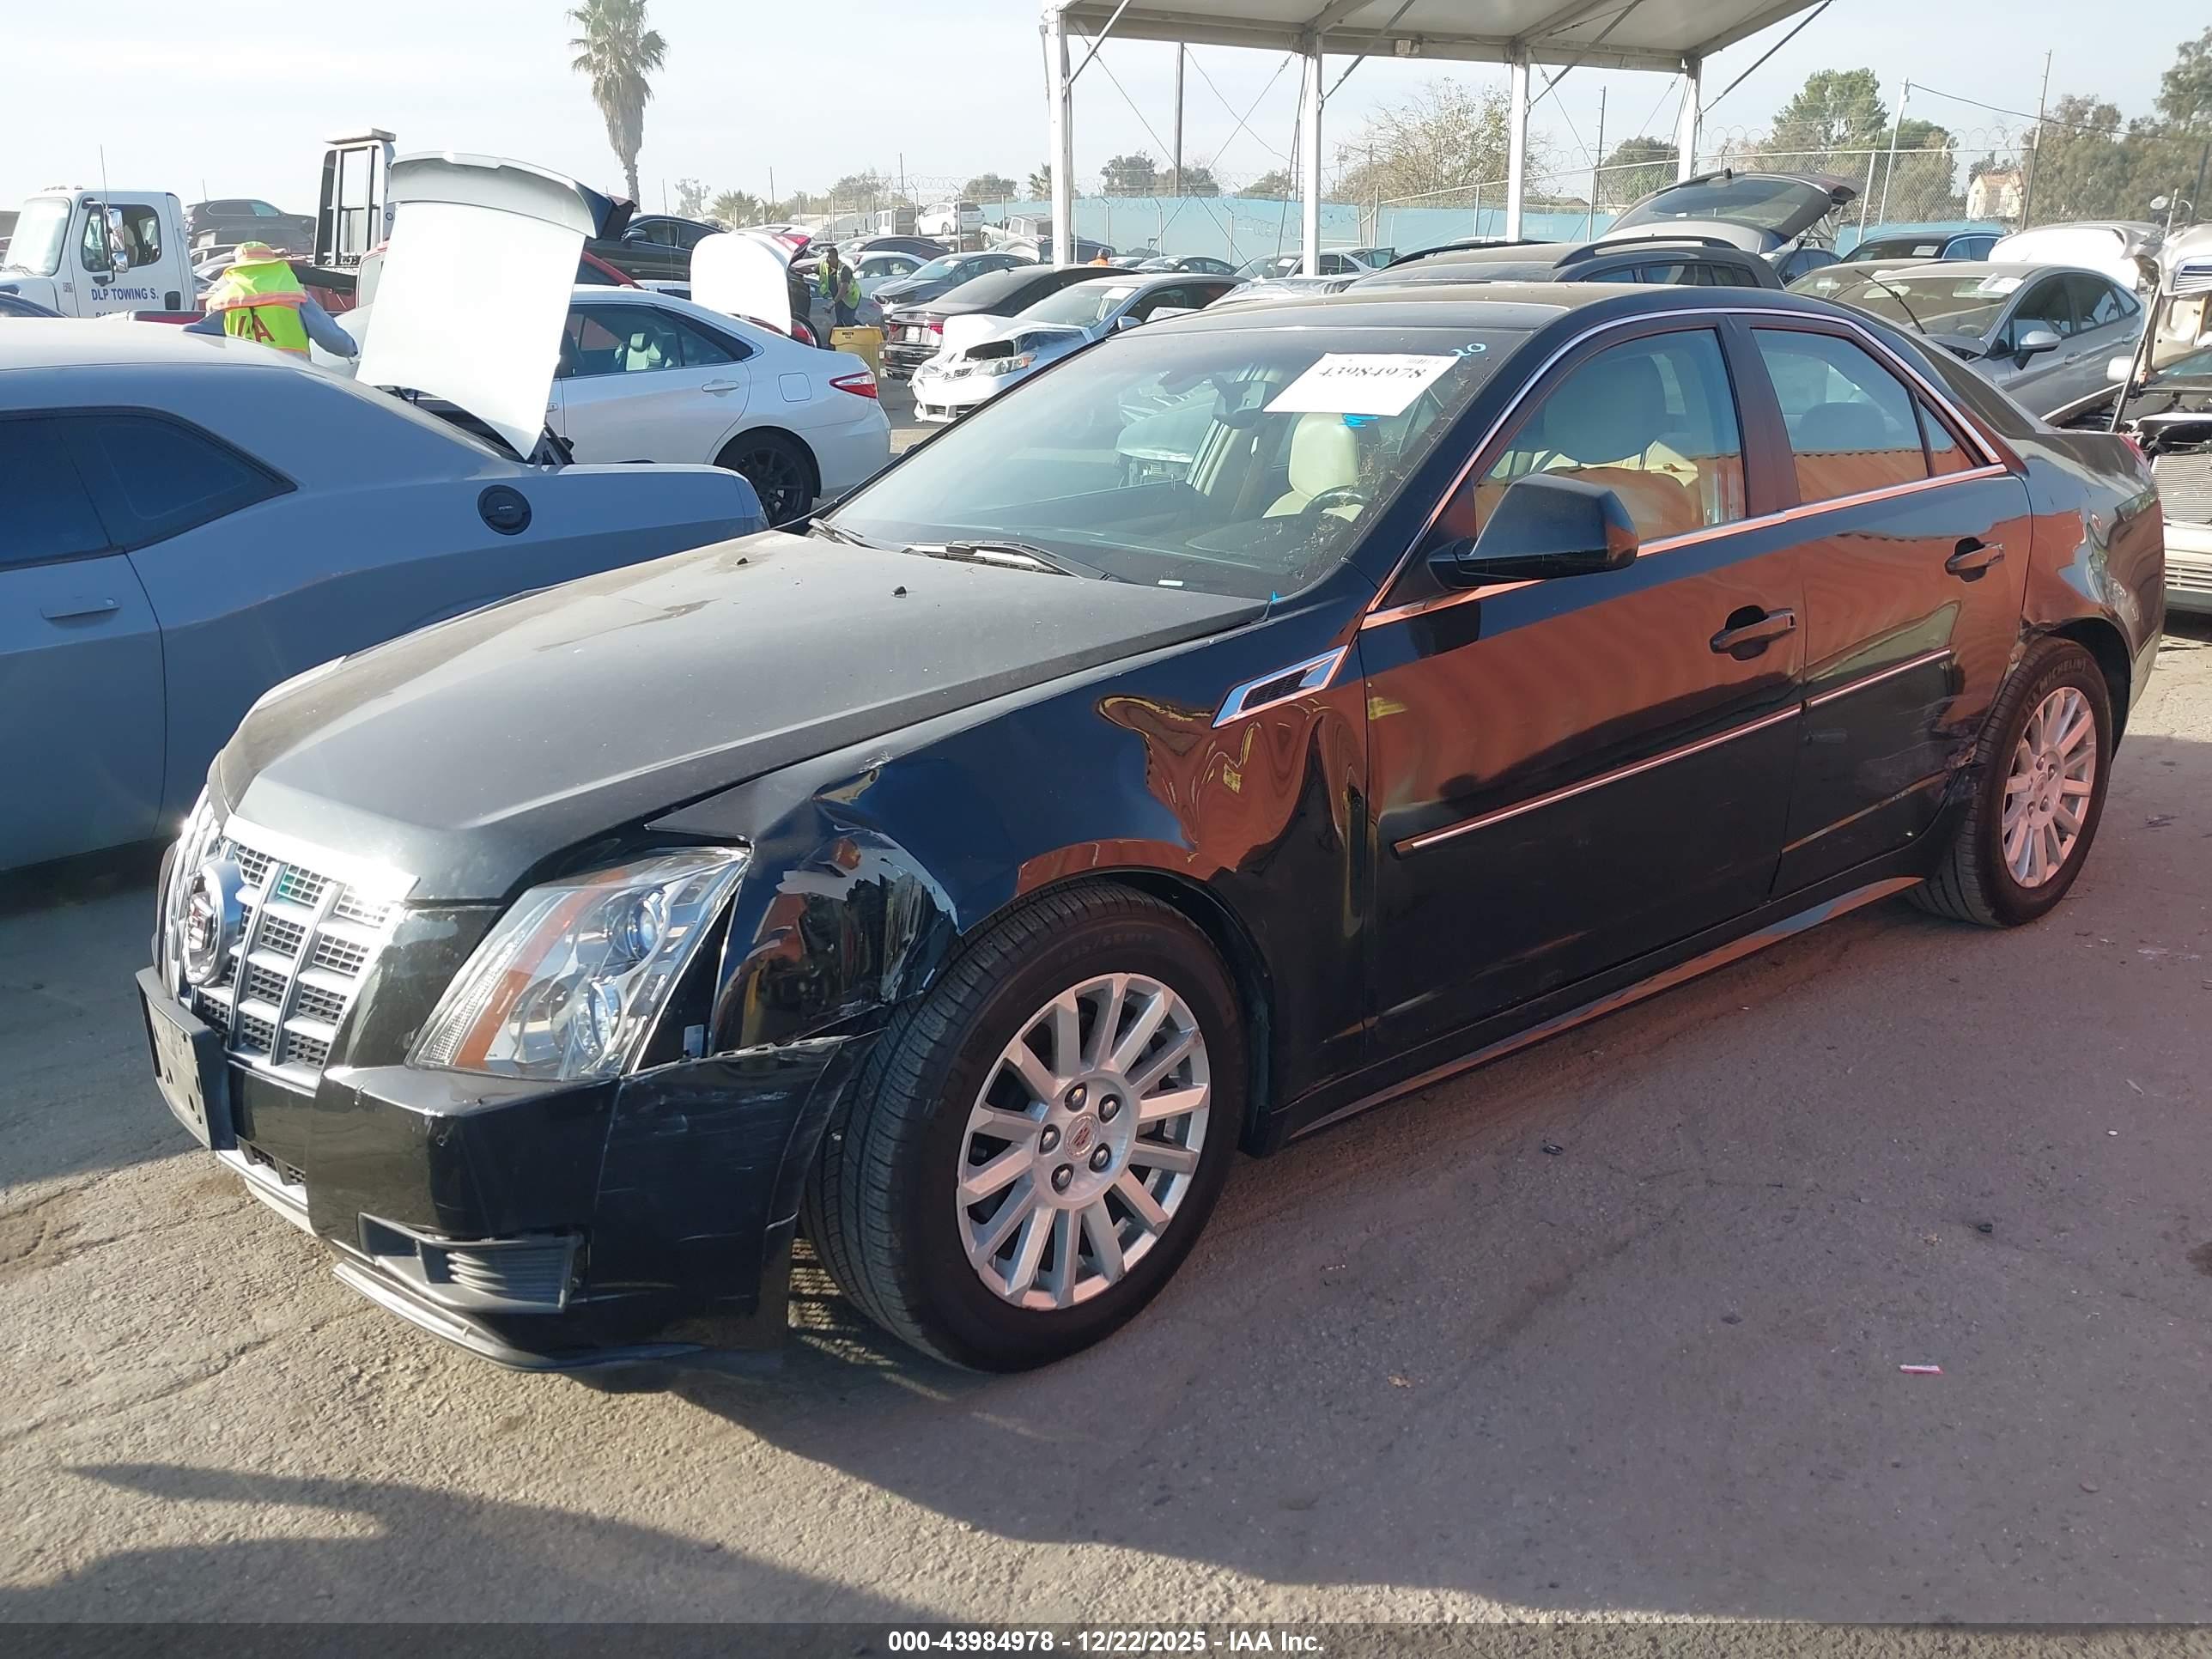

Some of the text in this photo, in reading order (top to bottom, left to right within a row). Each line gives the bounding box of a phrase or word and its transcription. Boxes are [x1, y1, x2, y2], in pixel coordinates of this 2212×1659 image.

[91, 288, 159, 301] DLP TOWING S.
